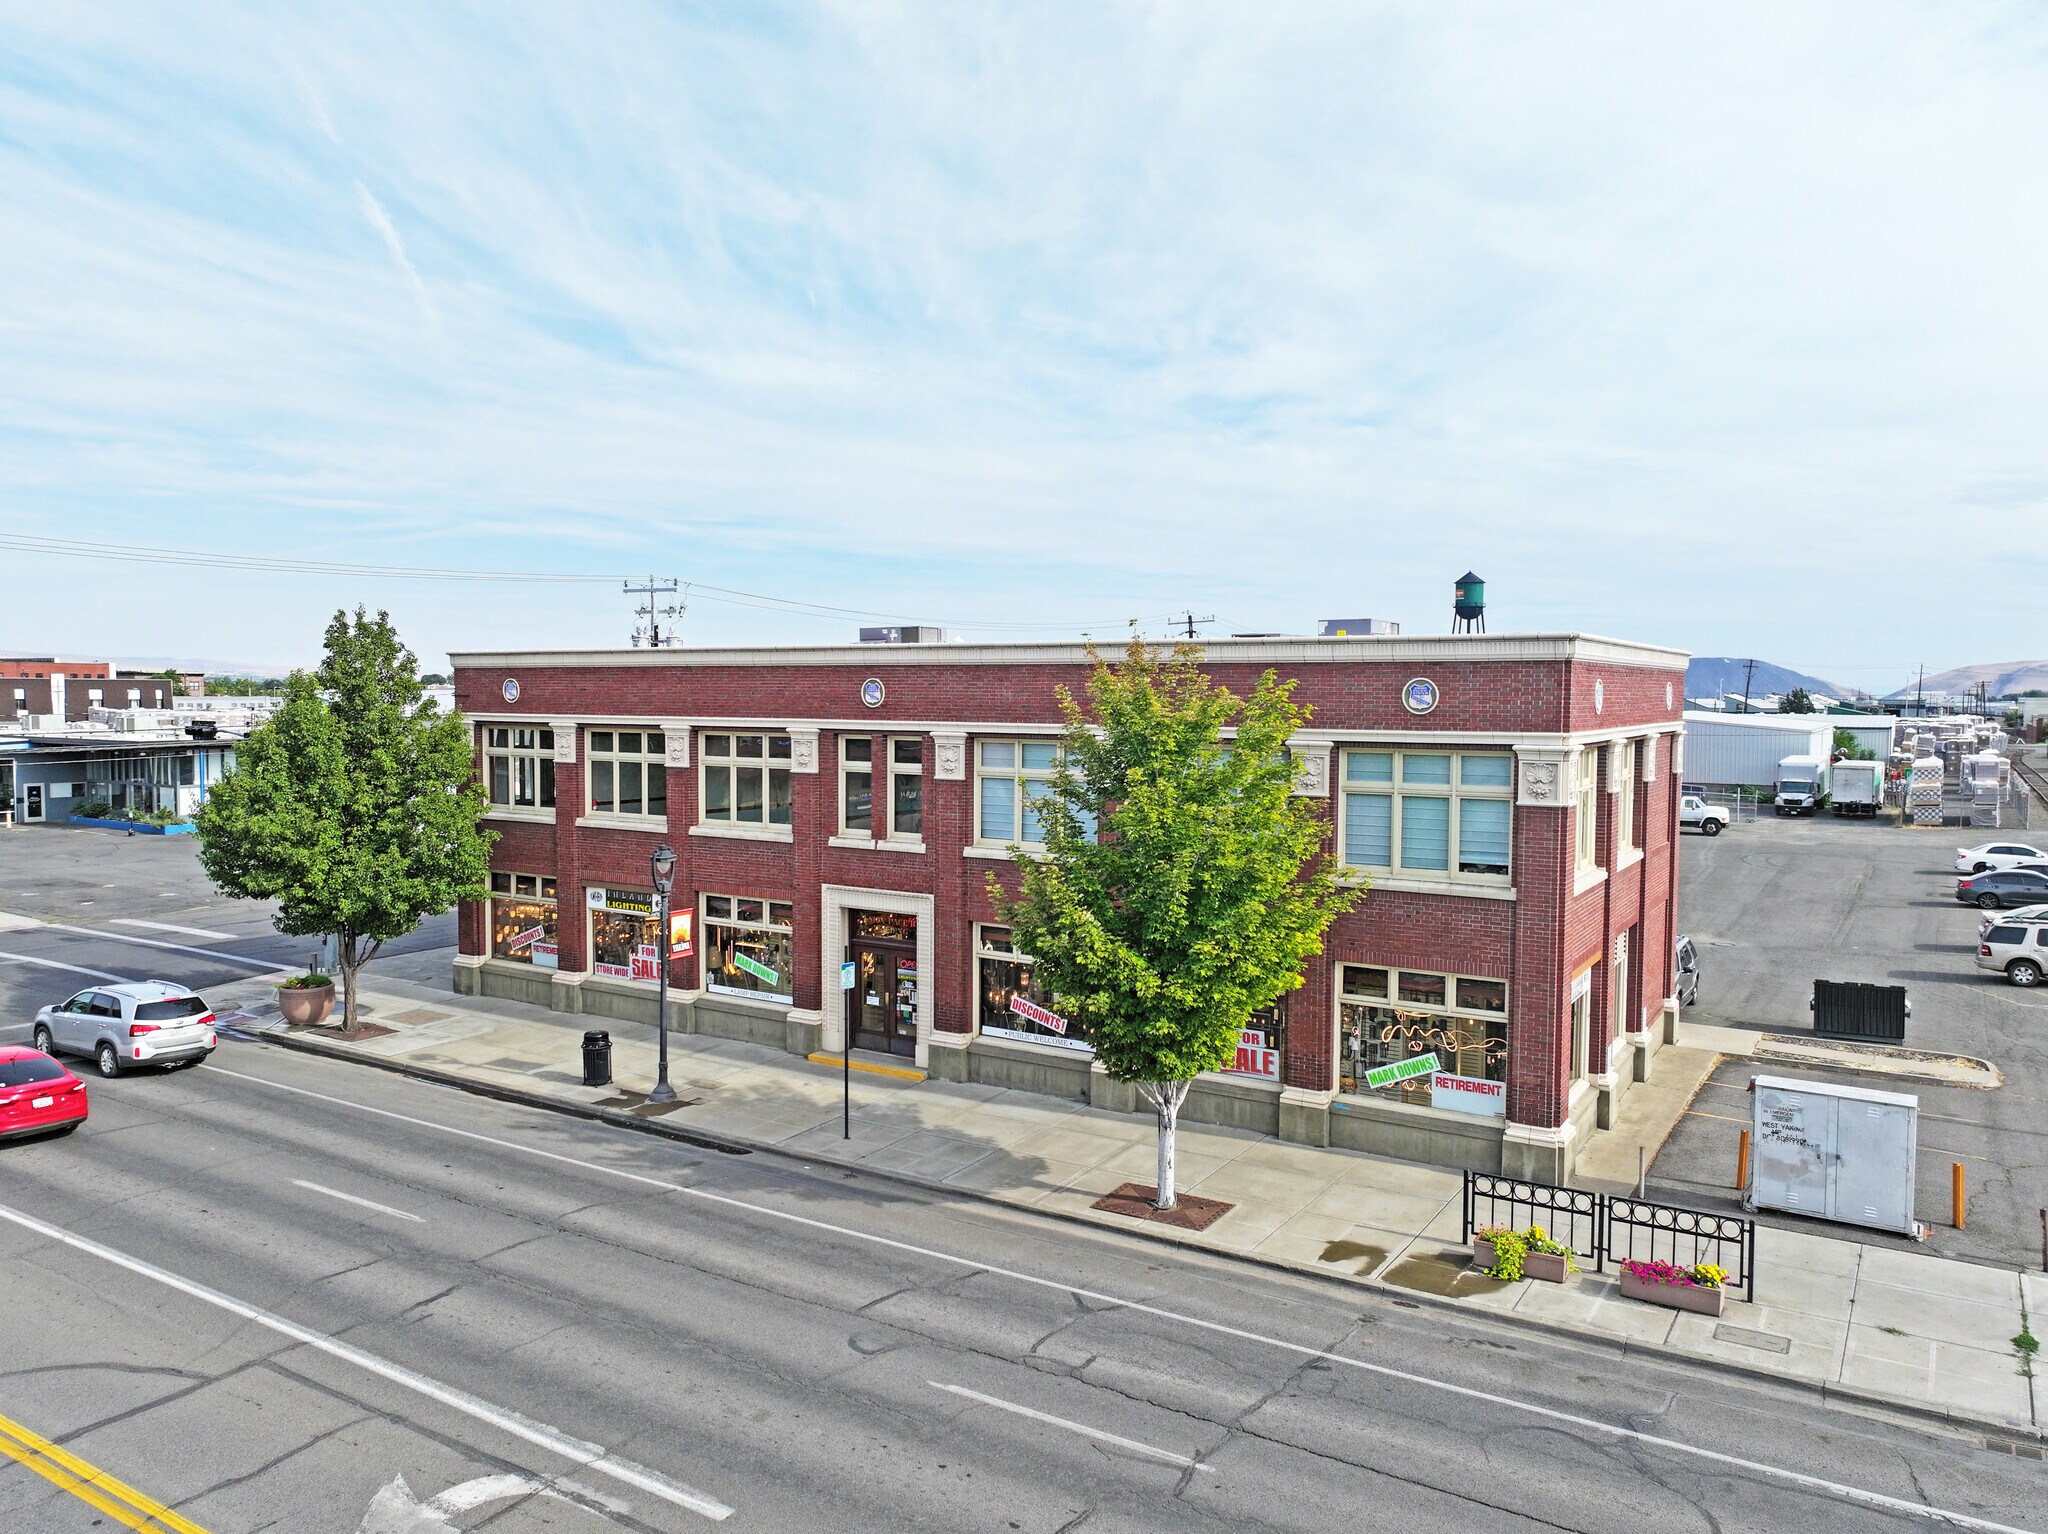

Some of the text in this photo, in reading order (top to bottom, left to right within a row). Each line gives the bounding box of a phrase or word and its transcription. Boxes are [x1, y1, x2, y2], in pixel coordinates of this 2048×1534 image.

[606, 901, 651, 912] LIGHTING
[533, 945, 558, 956] RETIREME
[641, 946, 656, 957] FOR
[736, 954, 752, 970] MARK
[900, 959, 917, 969] OPE
[596, 964, 629, 977] STORE WIDE
[1012, 998, 1066, 1032] DISCOUNTS!
[1008, 1031, 1069, 1046] PUBLIC WELCOME
[1242, 1031, 1260, 1046] OR
[1221, 1047, 1275, 1075] ALE
[1368, 1055, 1439, 1086] MARK DOWNS!
[1435, 1077, 1502, 1096] RETIREMENT
[1762, 1121, 1778, 1129] WEST
